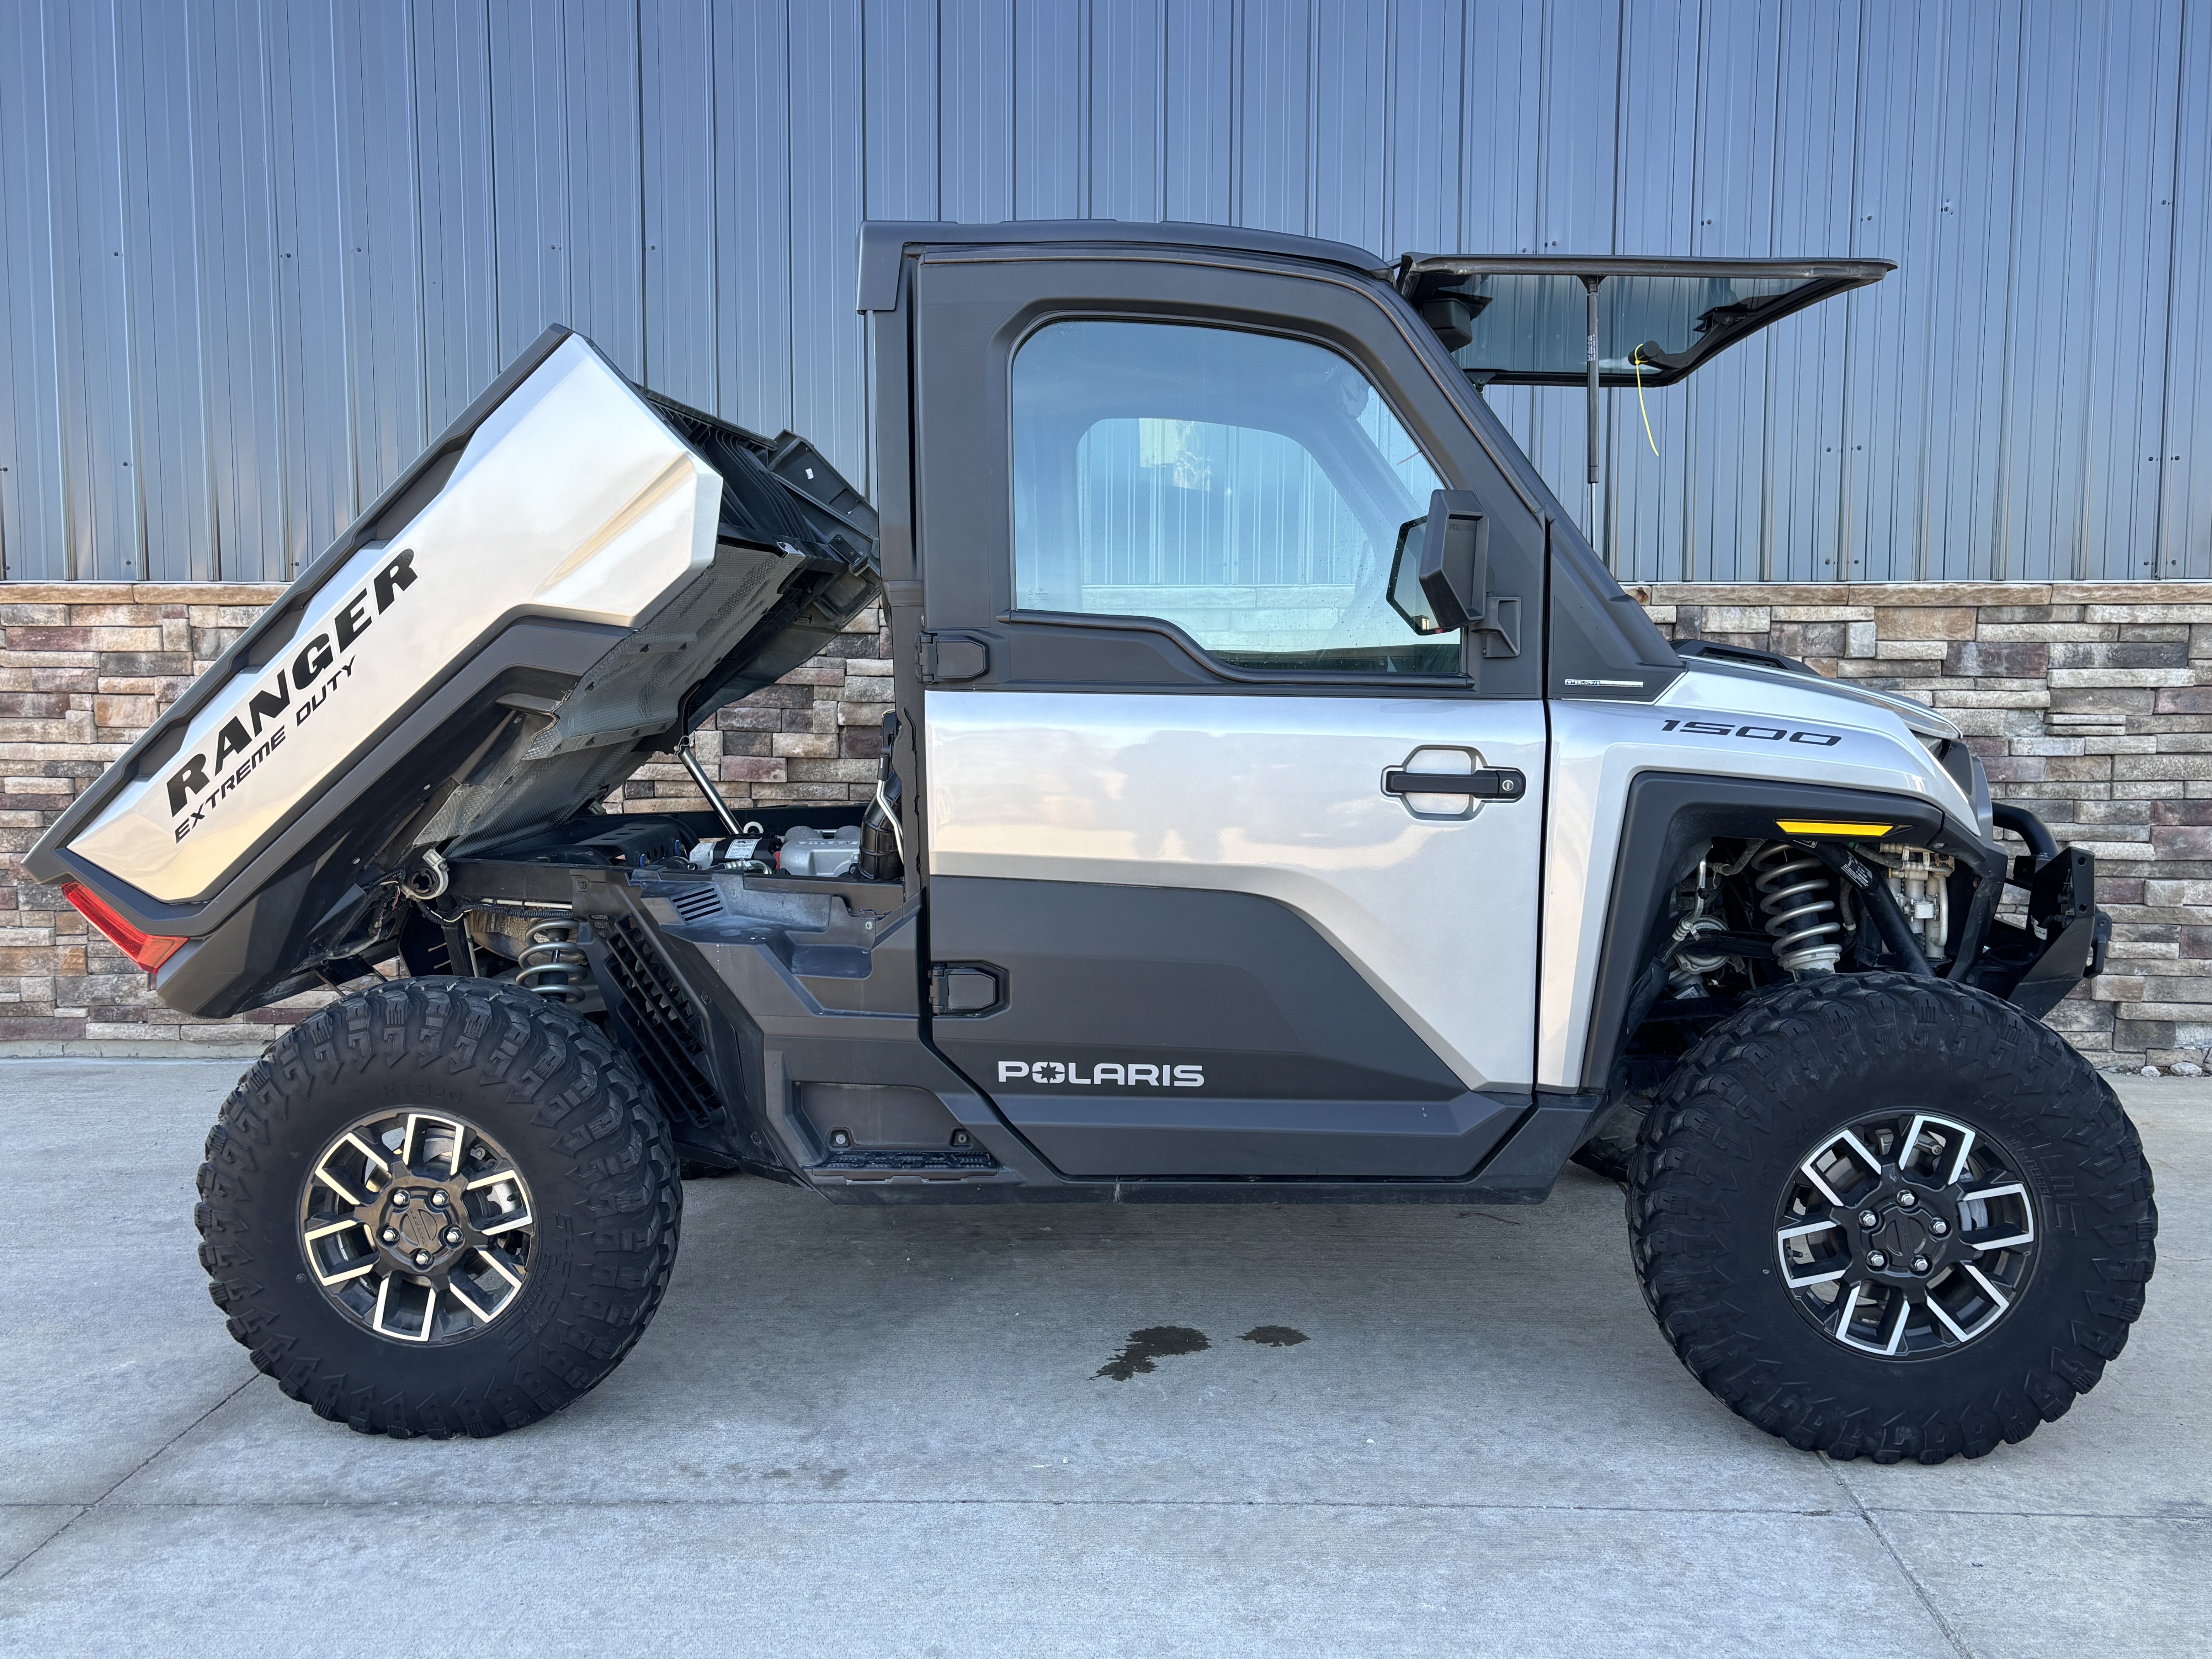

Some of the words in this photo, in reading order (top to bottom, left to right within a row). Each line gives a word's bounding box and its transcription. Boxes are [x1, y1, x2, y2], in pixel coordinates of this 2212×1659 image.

[167, 548, 418, 818] RANGER
[1661, 720, 1842, 746] 1500
[175, 725, 286, 843] EXTREME
[297, 655, 356, 727] DUTY
[998, 1061, 1204, 1087] POLARIS
[379, 1081, 410, 1097] RT
[416, 1082, 462, 1103] 320
